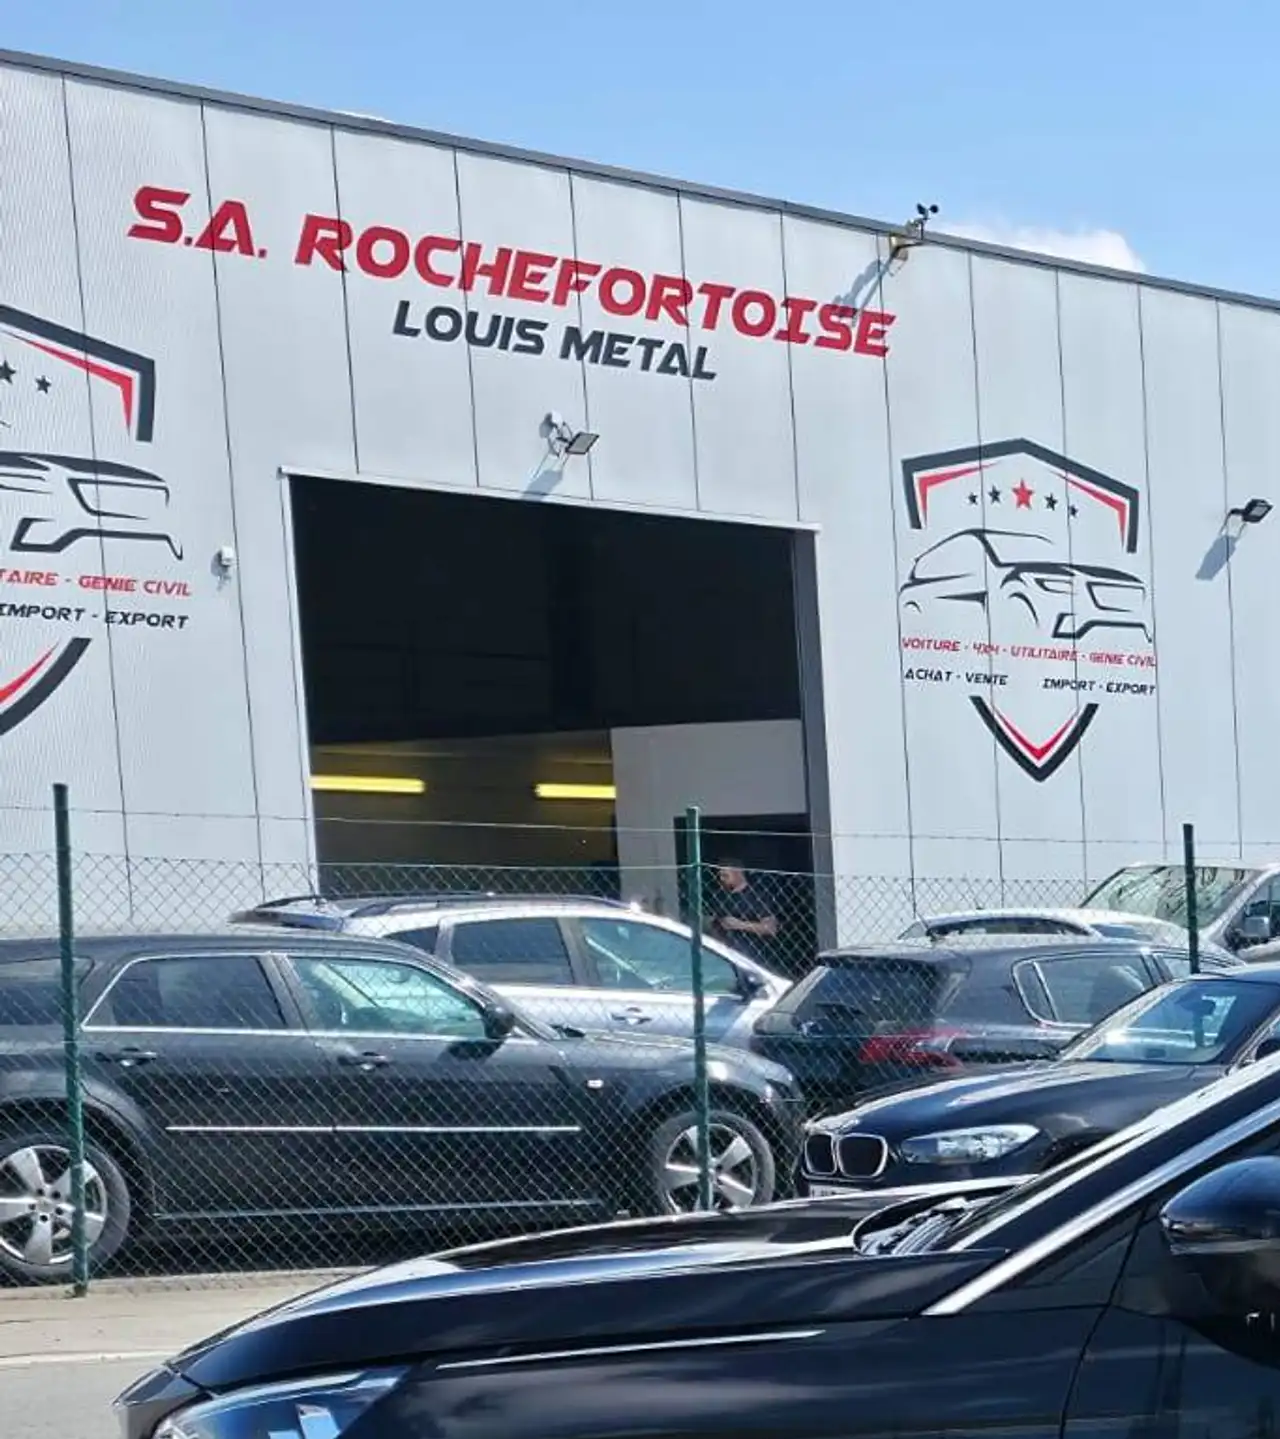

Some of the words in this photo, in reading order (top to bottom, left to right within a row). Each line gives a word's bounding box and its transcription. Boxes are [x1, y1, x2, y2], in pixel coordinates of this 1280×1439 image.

[127, 186, 267, 259] S.A.
[294, 213, 897, 358] ROCHEFORTOISE
[392, 300, 548, 355] LOUIS
[560, 325, 717, 381] METAL
[78, 575, 138, 592] GENIE
[143, 580, 191, 597] CIVIL
[105, 611, 189, 630] EXPORT
[902, 637, 961, 652] VOITURE
[1010, 645, 1078, 662] UTILITAIRE
[1089, 653, 1126, 666] GENIE
[1127, 656, 1156, 668] CIVIL
[905, 667, 953, 682] ACHAT
[965, 672, 1009, 686] VENTE
[1043, 677, 1096, 692] IMPORT
[1106, 680, 1156, 695] EXPORT
